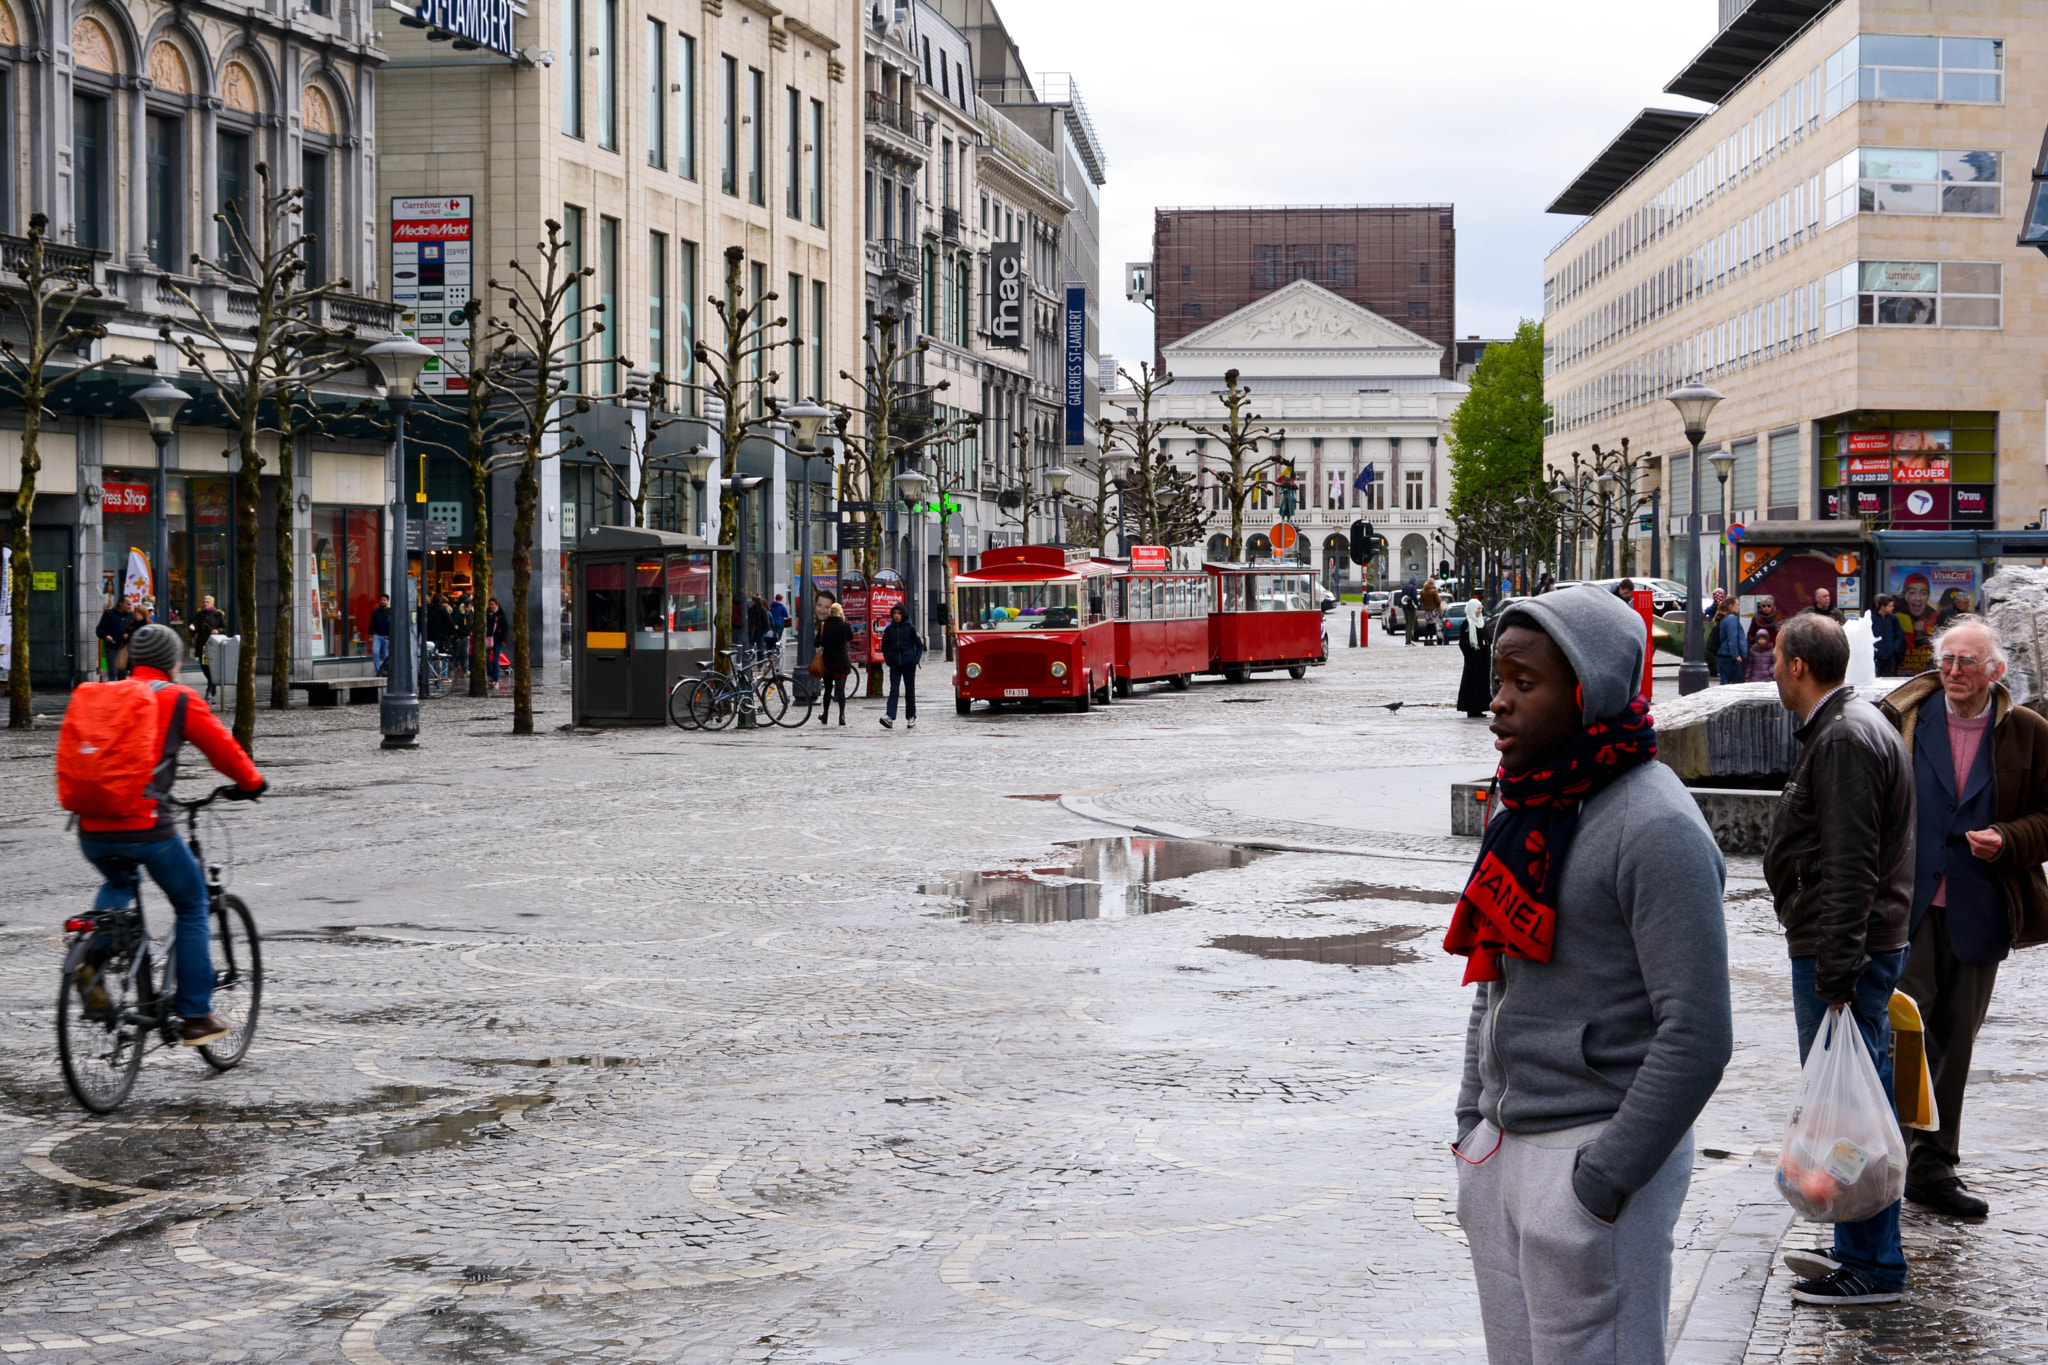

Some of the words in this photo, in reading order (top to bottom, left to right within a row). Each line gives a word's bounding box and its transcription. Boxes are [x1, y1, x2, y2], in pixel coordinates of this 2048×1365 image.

[1887, 160, 1925, 170] luminus
[402, 201, 441, 209] Carrefour
[394, 224, 429, 236] Media
[437, 223, 470, 235] Markt
[1885, 271, 1922, 280] luminus
[993, 257, 1019, 339] fnac
[1069, 365, 1082, 406] GALERIES
[1853, 433, 1886, 441] Commerces
[1852, 474, 1864, 482] 042
[1877, 473, 1889, 481] 220
[1908, 469, 1945, 478] LOUER
[101, 487, 122, 506] Press
[124, 488, 147, 511] Shop
[1858, 491, 1877, 501] Chrono
[1957, 491, 1980, 500] Chrono
[948, 528, 961, 548] fnac
[967, 529, 977, 548] fnac
[991, 532, 1006, 550] fnac
[1745, 552, 1773, 575] KIOSQUE
[1750, 560, 1777, 583] INFO
[842, 593, 867, 608] ightseeing
[872, 591, 903, 604] Sightseeing
[1476, 862, 1548, 947] HANEL
